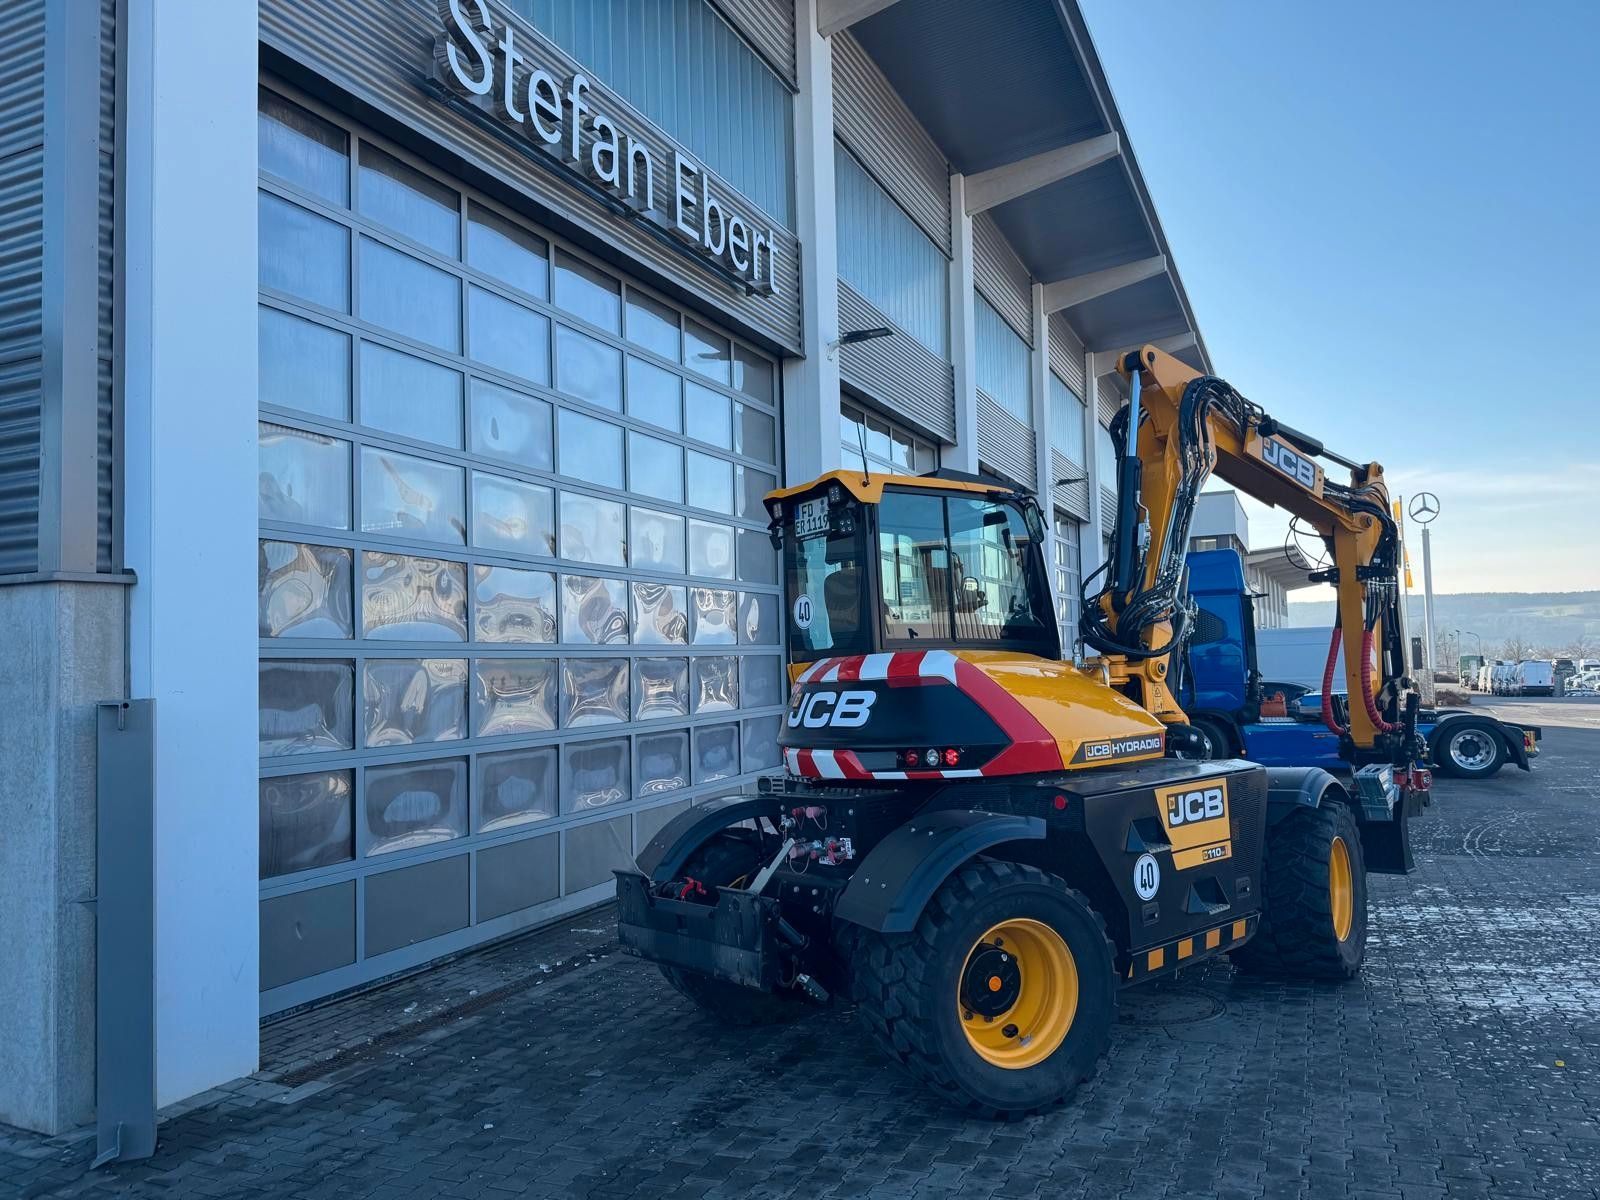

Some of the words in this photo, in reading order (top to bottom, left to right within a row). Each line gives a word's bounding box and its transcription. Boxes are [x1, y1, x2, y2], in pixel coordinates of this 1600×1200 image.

[446, 0, 653, 211] Stefan
[675, 152, 780, 294] Ebert
[1264, 442, 1314, 487] JCB
[801, 503, 813, 519] FD
[798, 601, 810, 622] 40
[787, 690, 877, 728] JCB
[1087, 744, 1110, 757] JCB
[1112, 738, 1160, 754] HYDRADIG
[1169, 788, 1224, 825] JCB
[1140, 862, 1155, 891] 40
